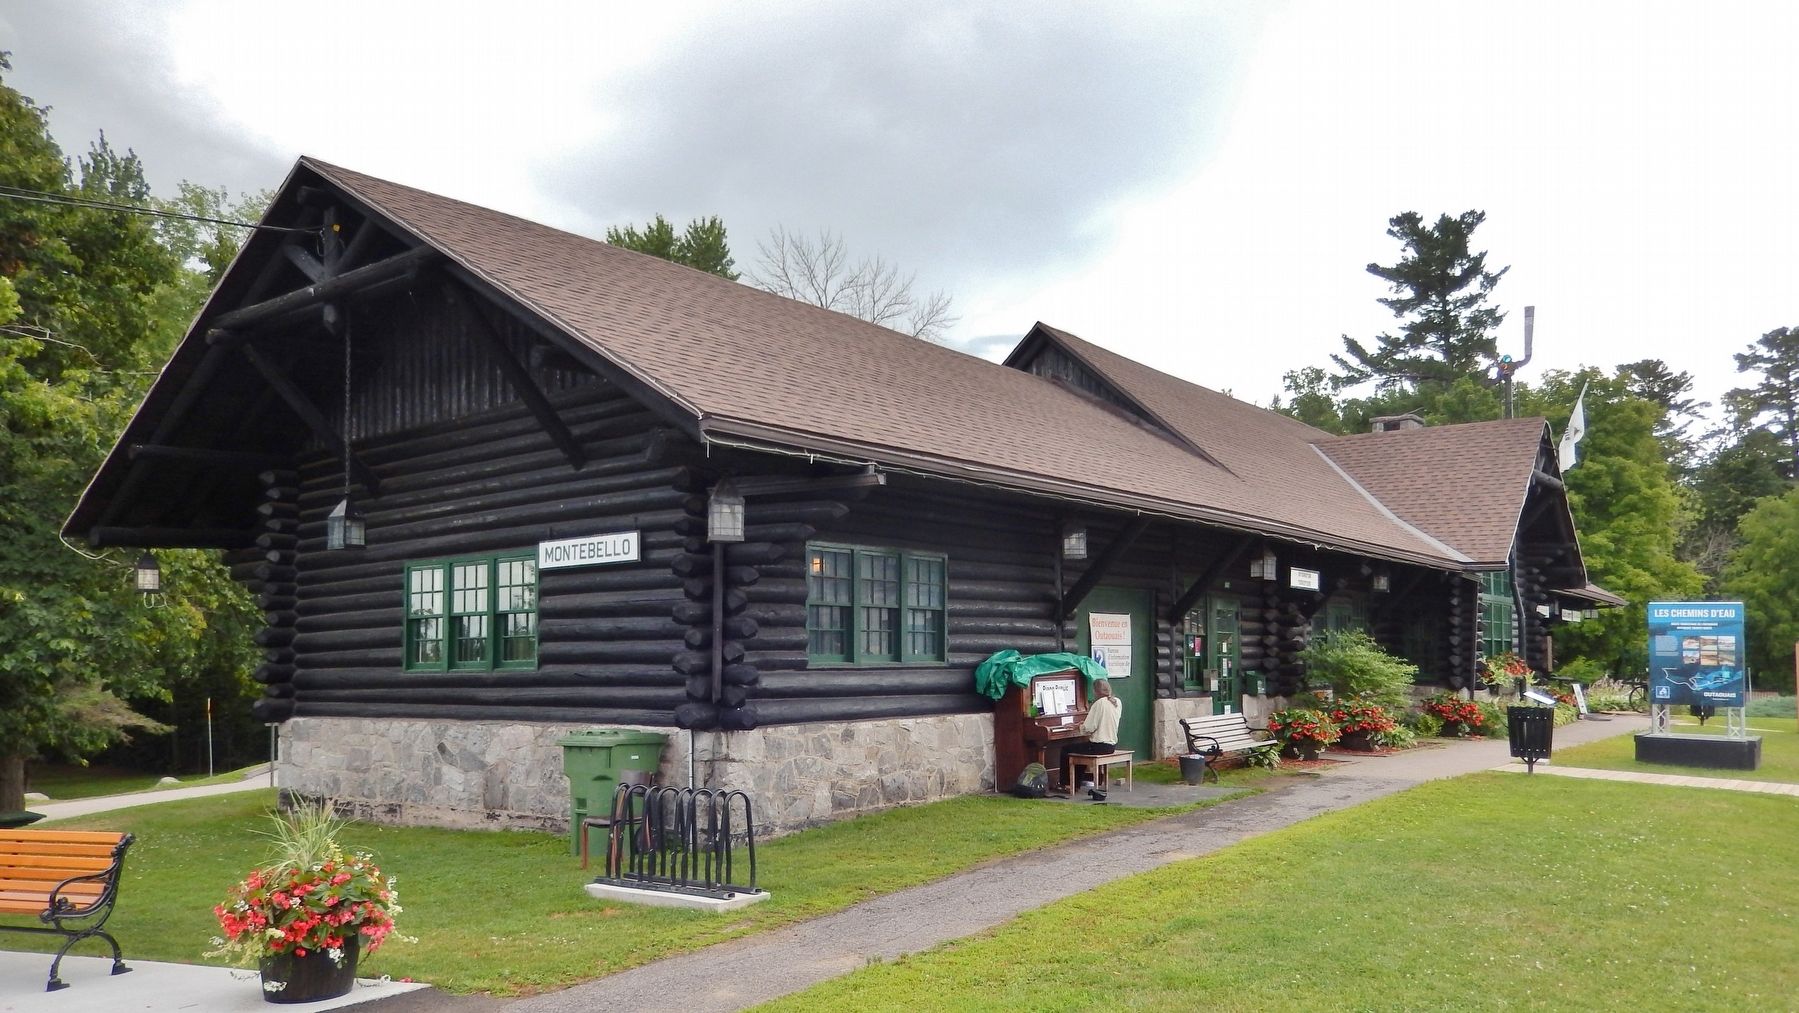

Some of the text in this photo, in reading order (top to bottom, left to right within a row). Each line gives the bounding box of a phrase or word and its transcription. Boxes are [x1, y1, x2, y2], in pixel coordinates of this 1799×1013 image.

[544, 538, 631, 563] MONTEBELLO
[1654, 608, 1736, 618] LES CHEMINS D'EAU
